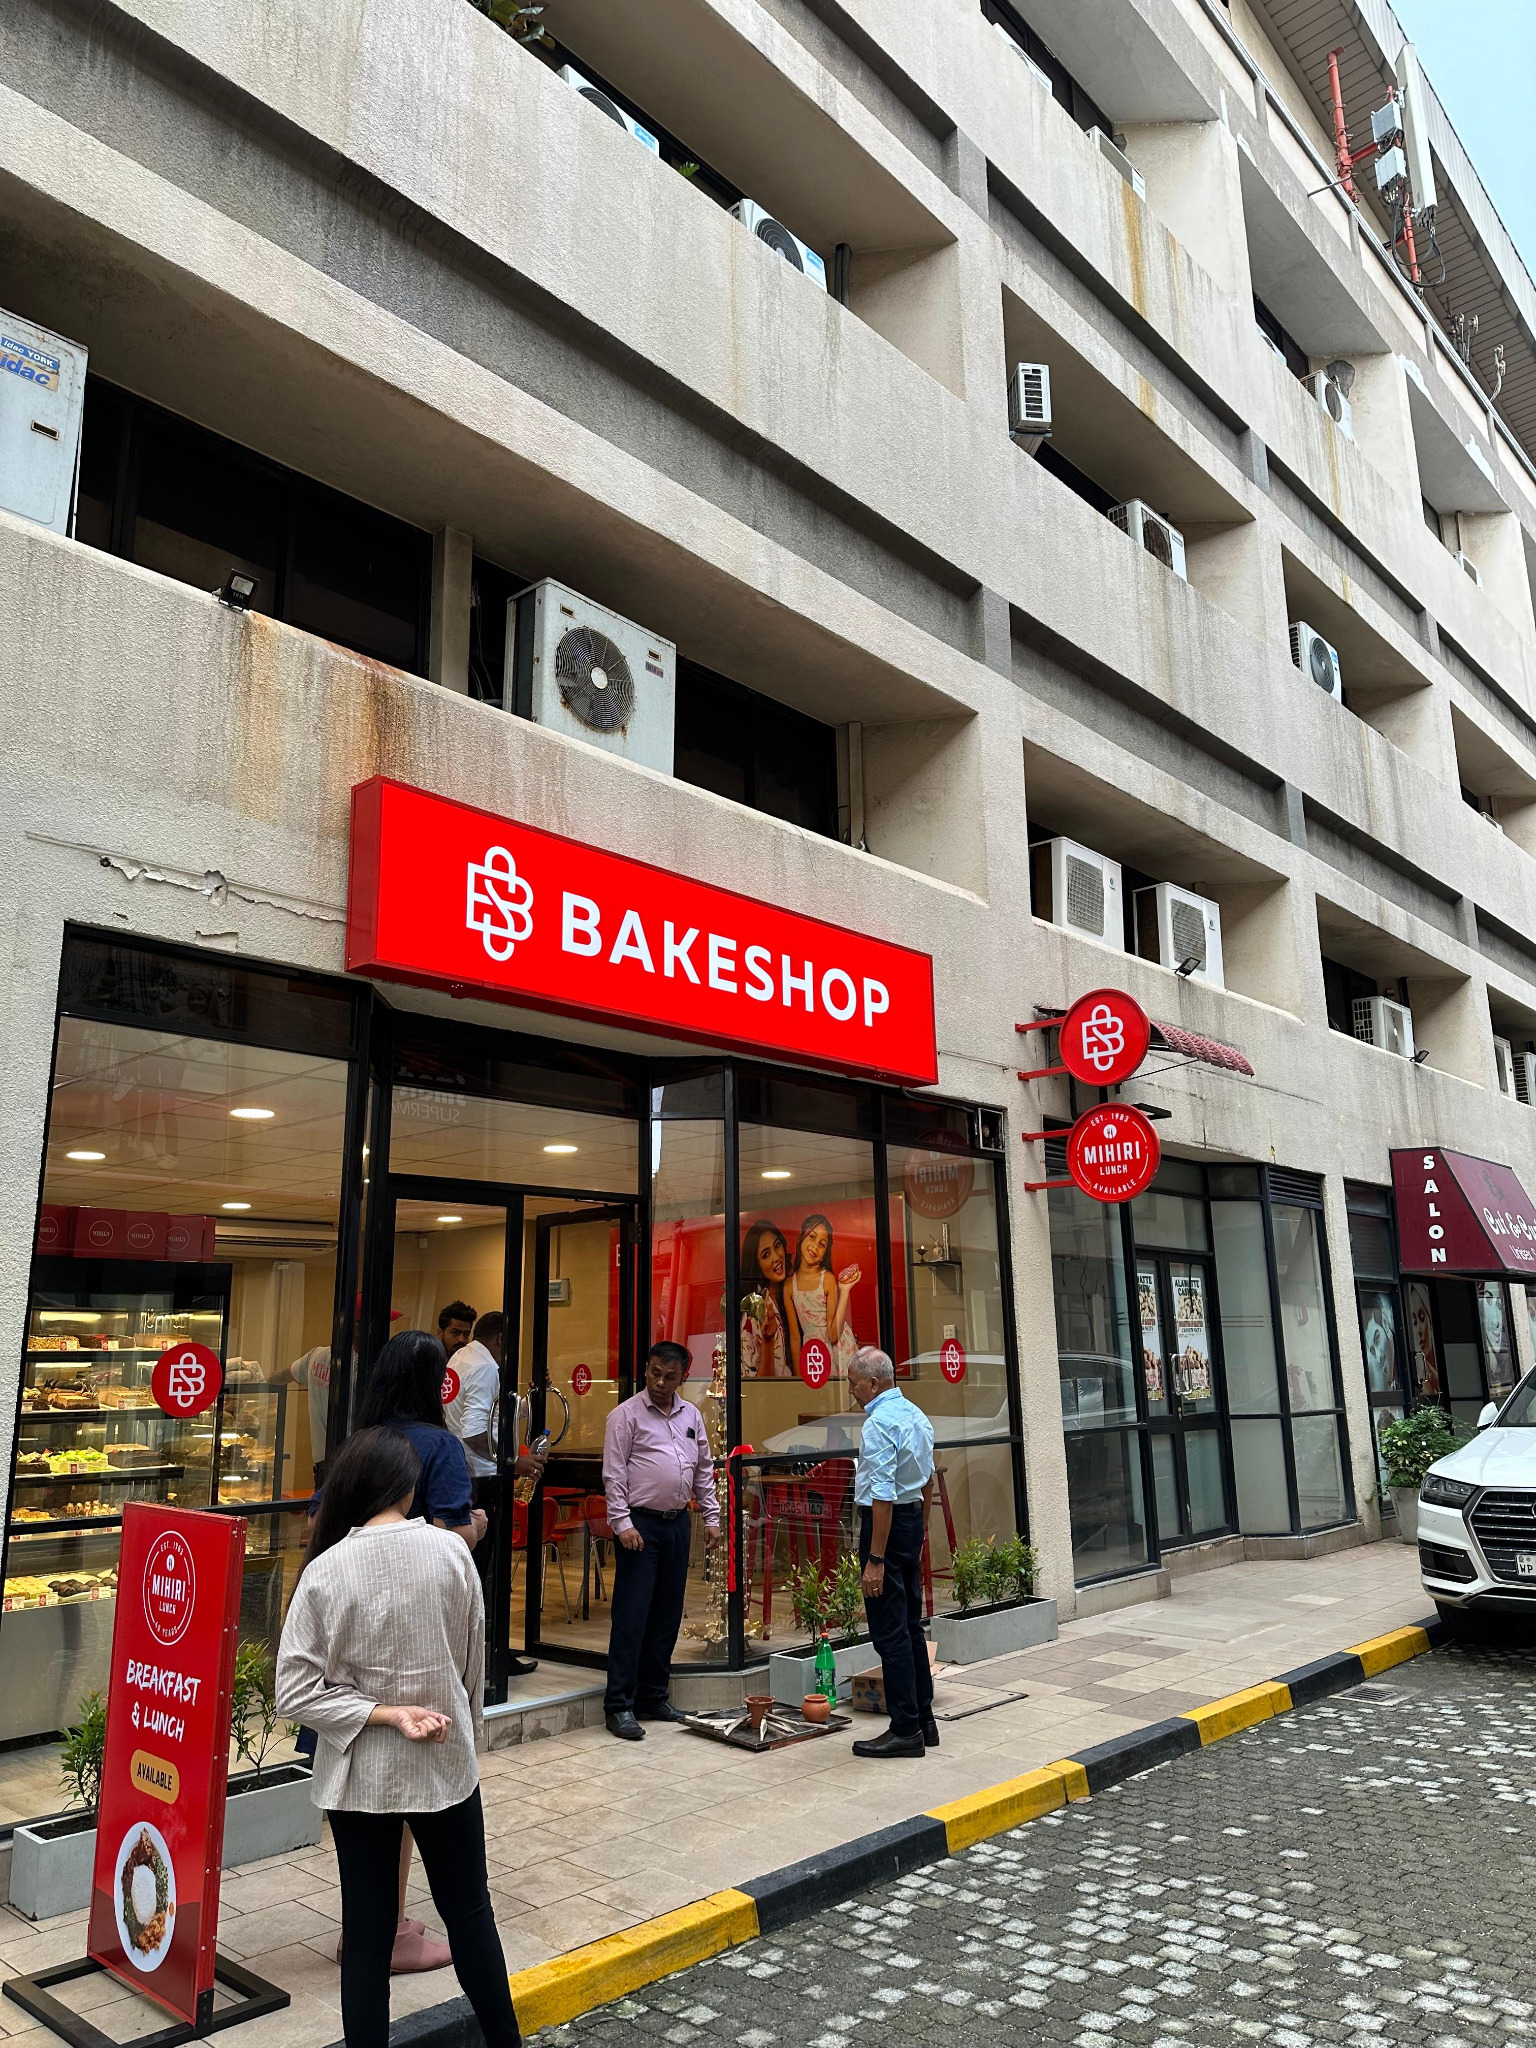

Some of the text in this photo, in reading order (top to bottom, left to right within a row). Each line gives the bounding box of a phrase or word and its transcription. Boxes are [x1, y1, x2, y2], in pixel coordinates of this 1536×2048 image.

[28, 350, 54, 367] YORK
[561, 891, 890, 1027] BAKESHOP
[1090, 1112, 1130, 1127] EST. 1983
[1084, 1140, 1141, 1165] MIHIRI
[1099, 1164, 1128, 1176] LUNCH
[1093, 1178, 1137, 1195] AVAILABLE
[1423, 1155, 1447, 1263] SALON
[1483, 1207, 1510, 1235] Cut
[1505, 1212, 1522, 1238] &
[1519, 1564, 1533, 1573] WP
[152, 1573, 186, 1602] MIHIRI
[159, 1600, 176, 1615] LUNCH
[126, 1658, 201, 1706] BREAKFAST
[131, 1700, 185, 1742] & LUNCH
[136, 1761, 173, 1791] AVAILABLE
